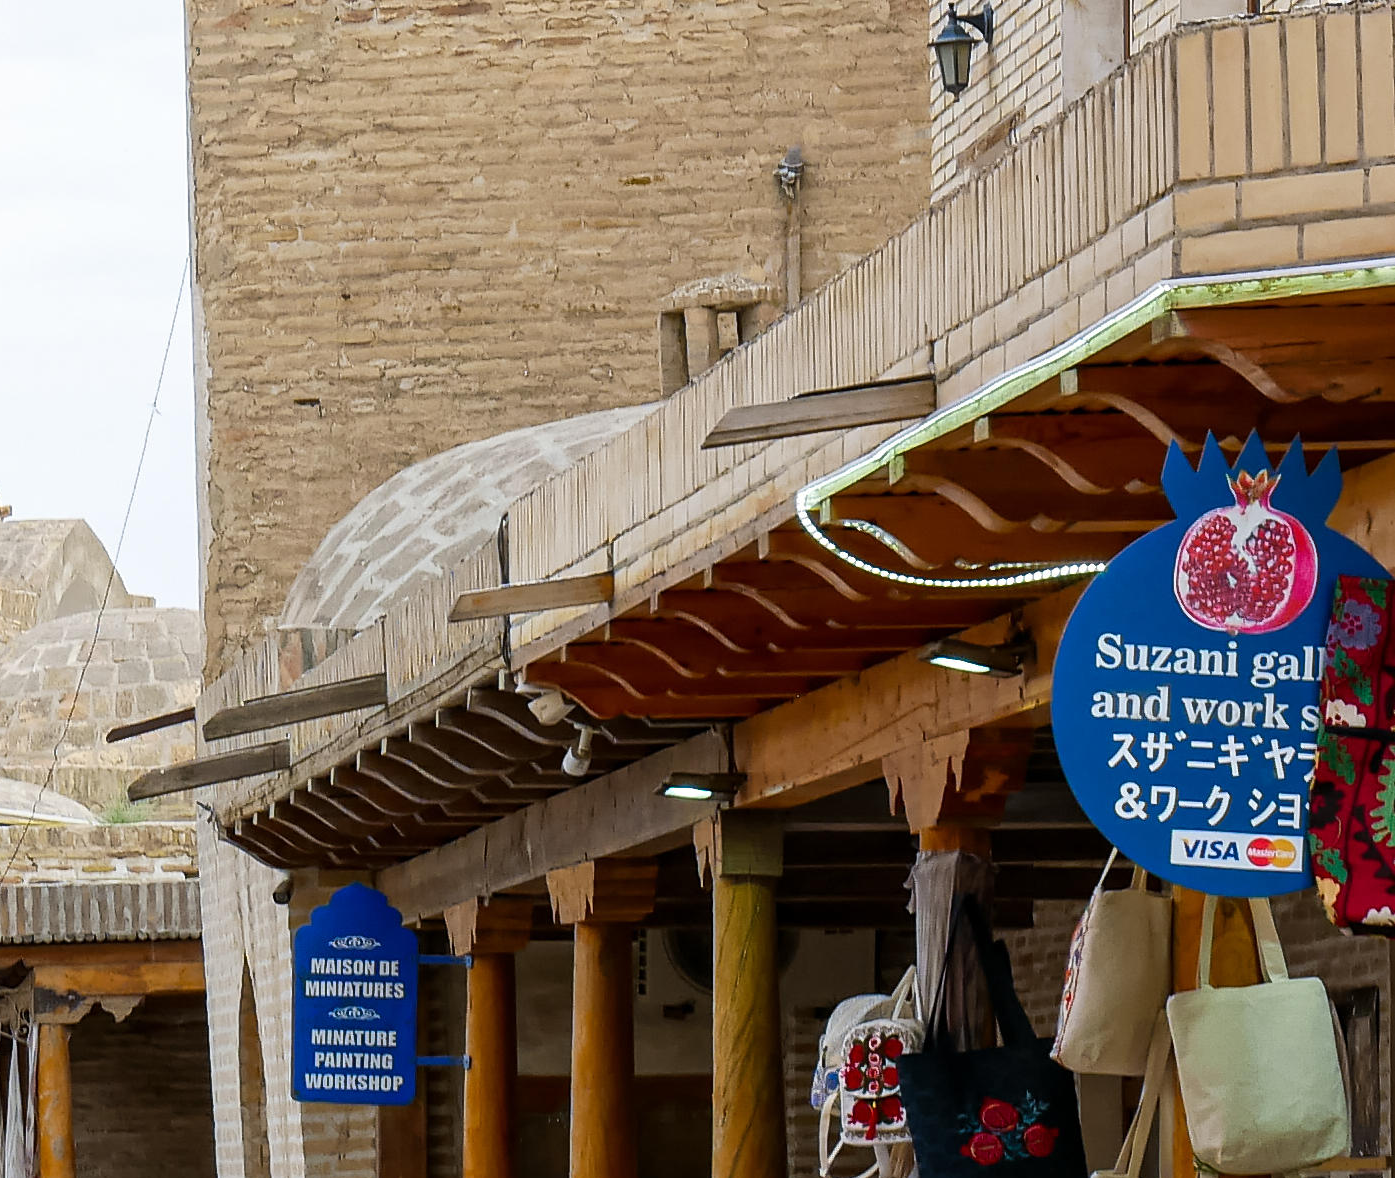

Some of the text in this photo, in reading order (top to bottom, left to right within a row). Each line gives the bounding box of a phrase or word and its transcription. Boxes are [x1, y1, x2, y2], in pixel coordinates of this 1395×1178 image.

[1095, 633, 1238, 678] Suzani
[1091, 686, 1171, 722] and
[1182, 693, 1290, 730] work
[1182, 838, 1239, 861] VISA
[310, 957, 399, 977] MAISON DE
[305, 980, 405, 999] MINIATURES
[311, 1028, 397, 1047] MINATURE
[314, 1052, 393, 1070] PAINTING
[305, 1073, 404, 1092] WORKSHOP
